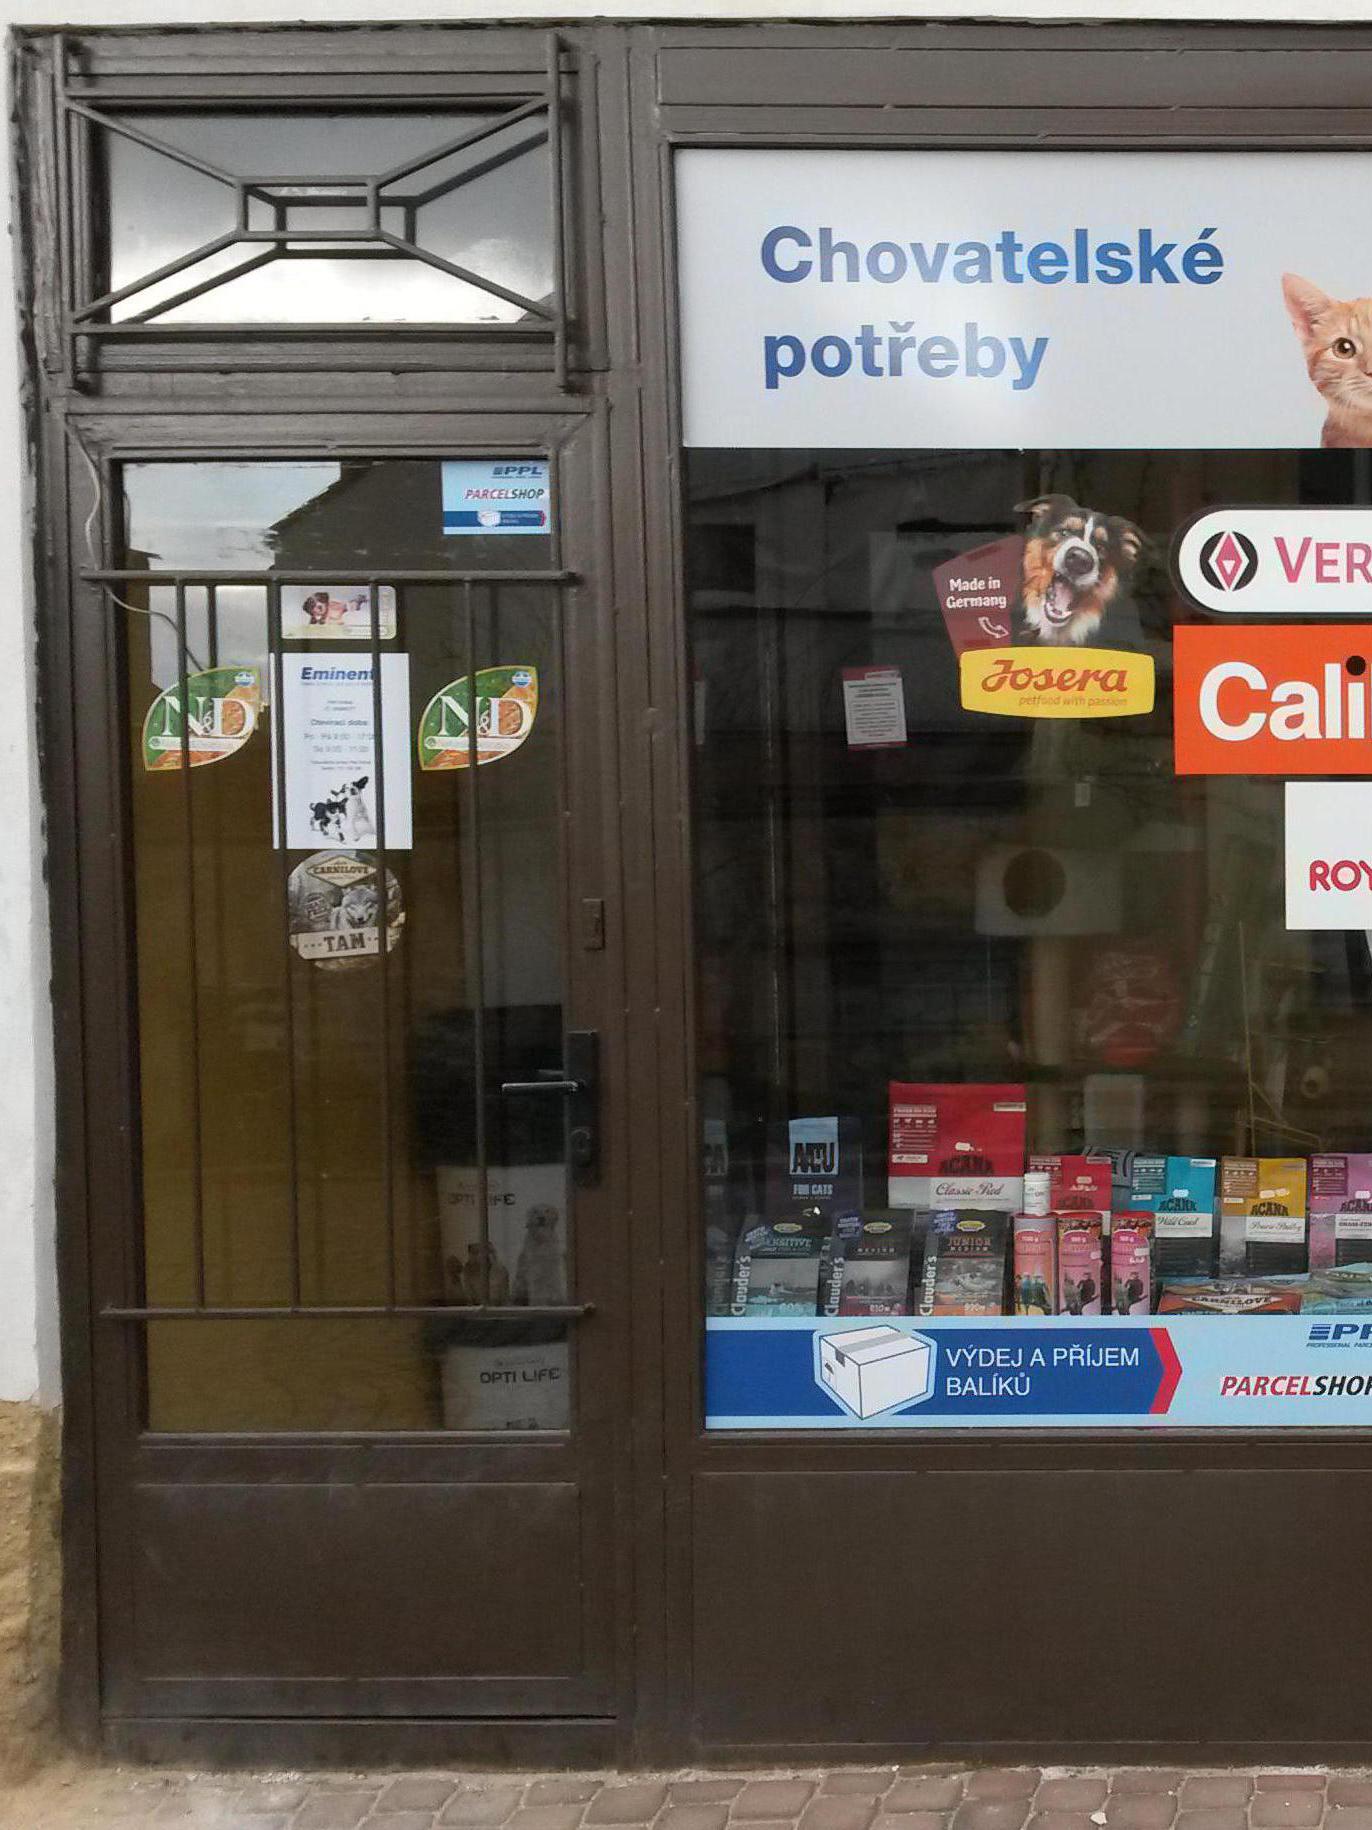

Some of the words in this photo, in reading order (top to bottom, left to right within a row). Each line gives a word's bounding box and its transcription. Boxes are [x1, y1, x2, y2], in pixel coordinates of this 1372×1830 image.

[760, 225, 1224, 285] Chovatelské
[764, 321, 1050, 391] potřeby
[464, 488, 544, 499] PARCELSHOP
[950, 578, 985, 592] Made
[988, 577, 1001, 590] in
[946, 594, 1007, 611] Germany
[981, 659, 1128, 693] Josera
[1063, 695, 1086, 706] with
[1088, 696, 1128, 707] passion
[323, 932, 366, 952] TAM
[731, 1256, 751, 1316] Clauder's
[824, 1257, 844, 1316] Clauder's
[920, 1255, 938, 1316] Clauder's
[945, 1344, 1023, 1368] VÝDEJ
[1029, 1348, 1046, 1367] A
[1053, 1343, 1140, 1367] PŘÍJEM
[480, 1371, 516, 1384] OPTI
[522, 1368, 560, 1382] LIFE
[945, 1371, 1031, 1397] BALÍKŮ
